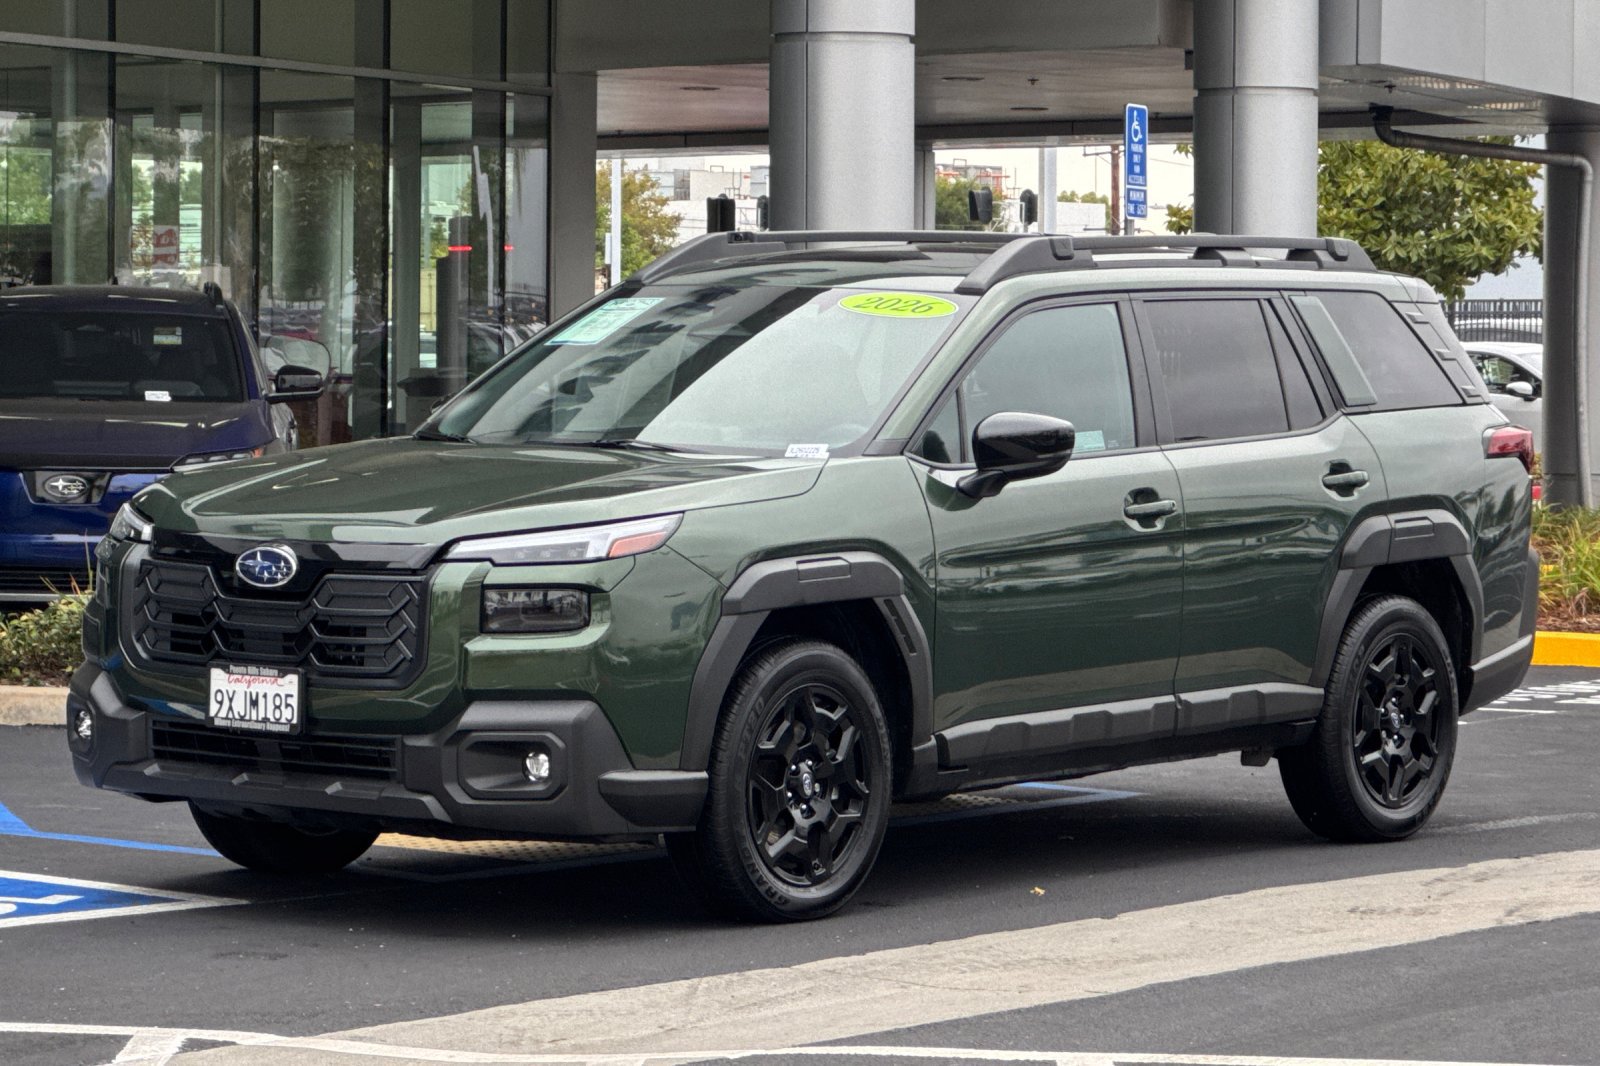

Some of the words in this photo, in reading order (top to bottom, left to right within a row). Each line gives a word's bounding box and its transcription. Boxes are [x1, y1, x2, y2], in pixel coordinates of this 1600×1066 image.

[852, 296, 944, 313] 2026
[228, 674, 284, 689] California
[214, 689, 295, 723] 9XJM185
